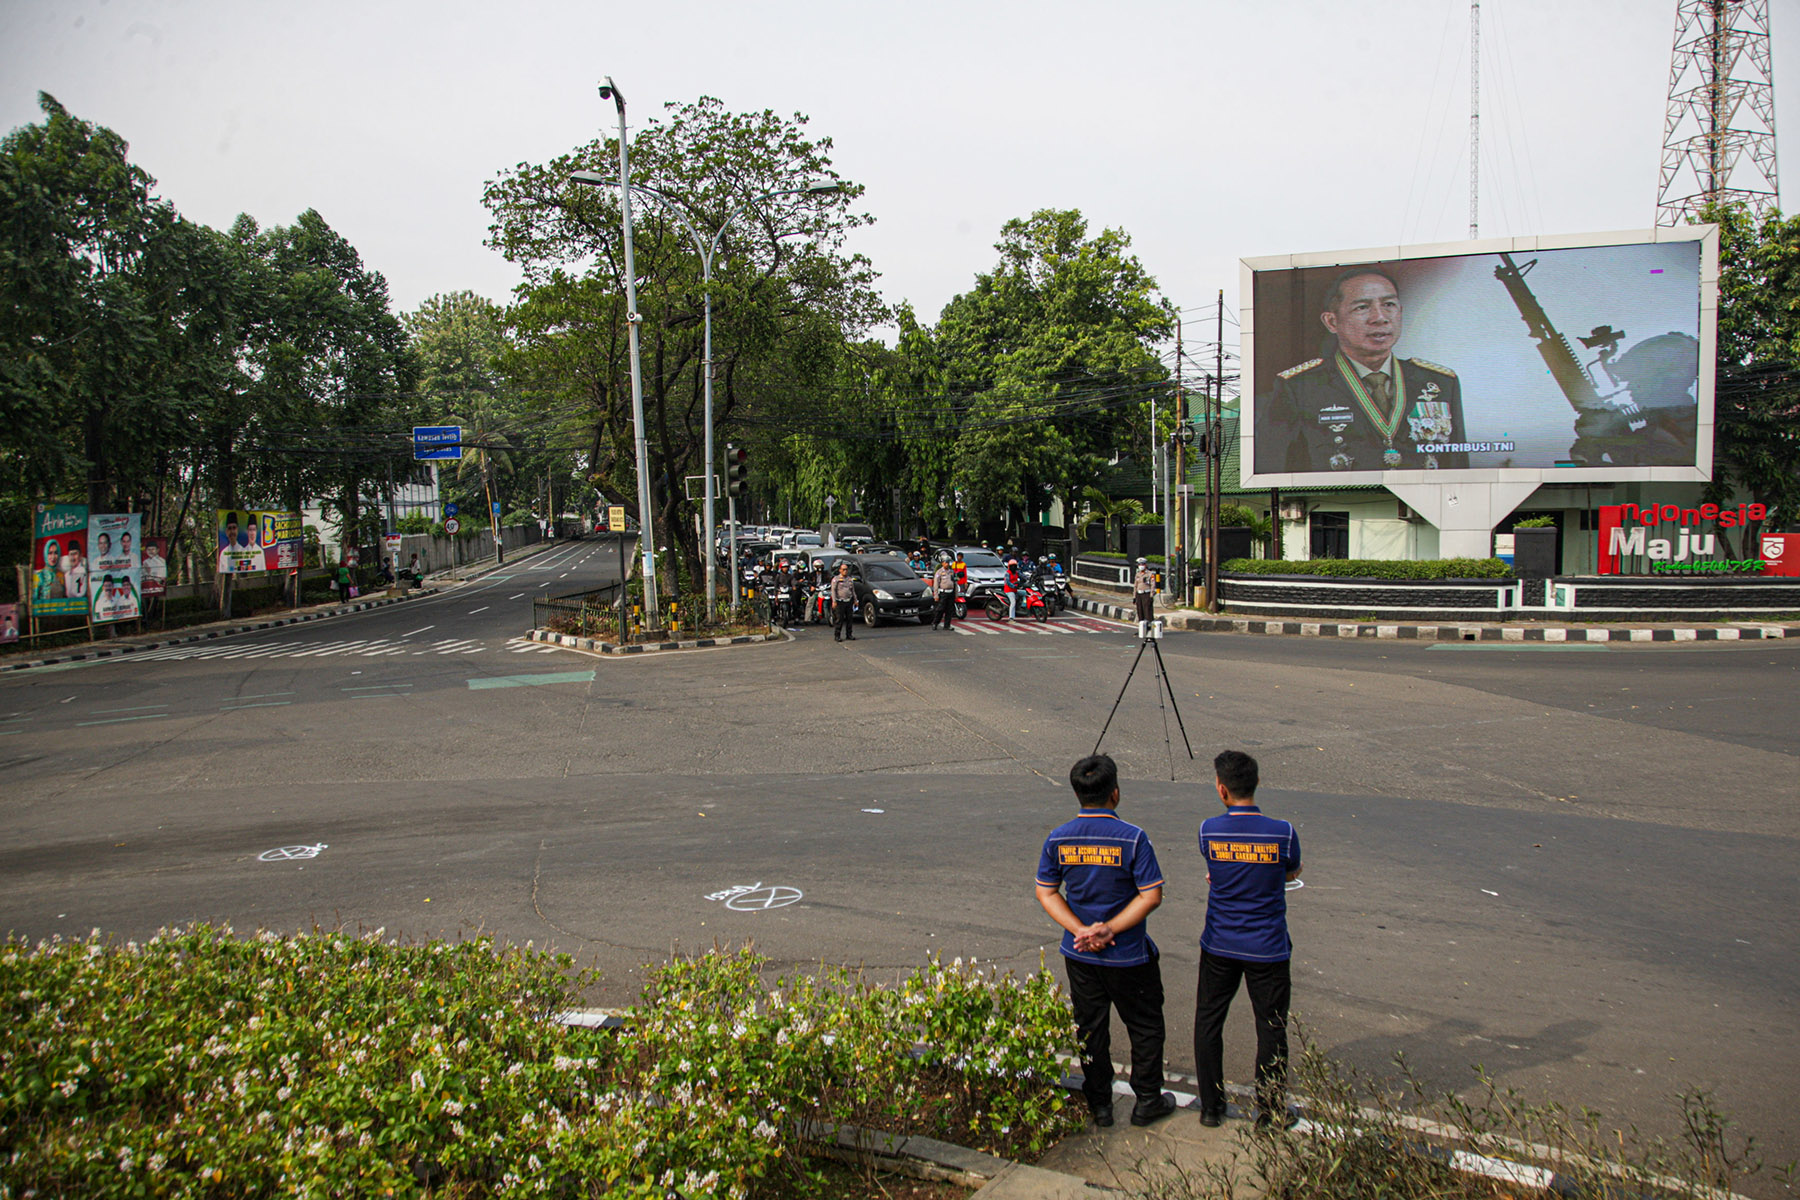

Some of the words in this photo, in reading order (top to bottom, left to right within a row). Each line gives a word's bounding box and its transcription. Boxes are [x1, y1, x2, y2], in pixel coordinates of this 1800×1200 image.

[1416, 442, 1491, 453] KONTRIBUSI
[1493, 441, 1514, 451] TNI
[264, 516, 273, 543] 3
[1609, 527, 1715, 561] Maju
[1078, 847, 1098, 855] ACCIDENT
[1099, 848, 1120, 856] ANALYSIS
[1230, 844, 1252, 853] ACCIDENT
[1253, 845, 1277, 853] ANALYSIS
